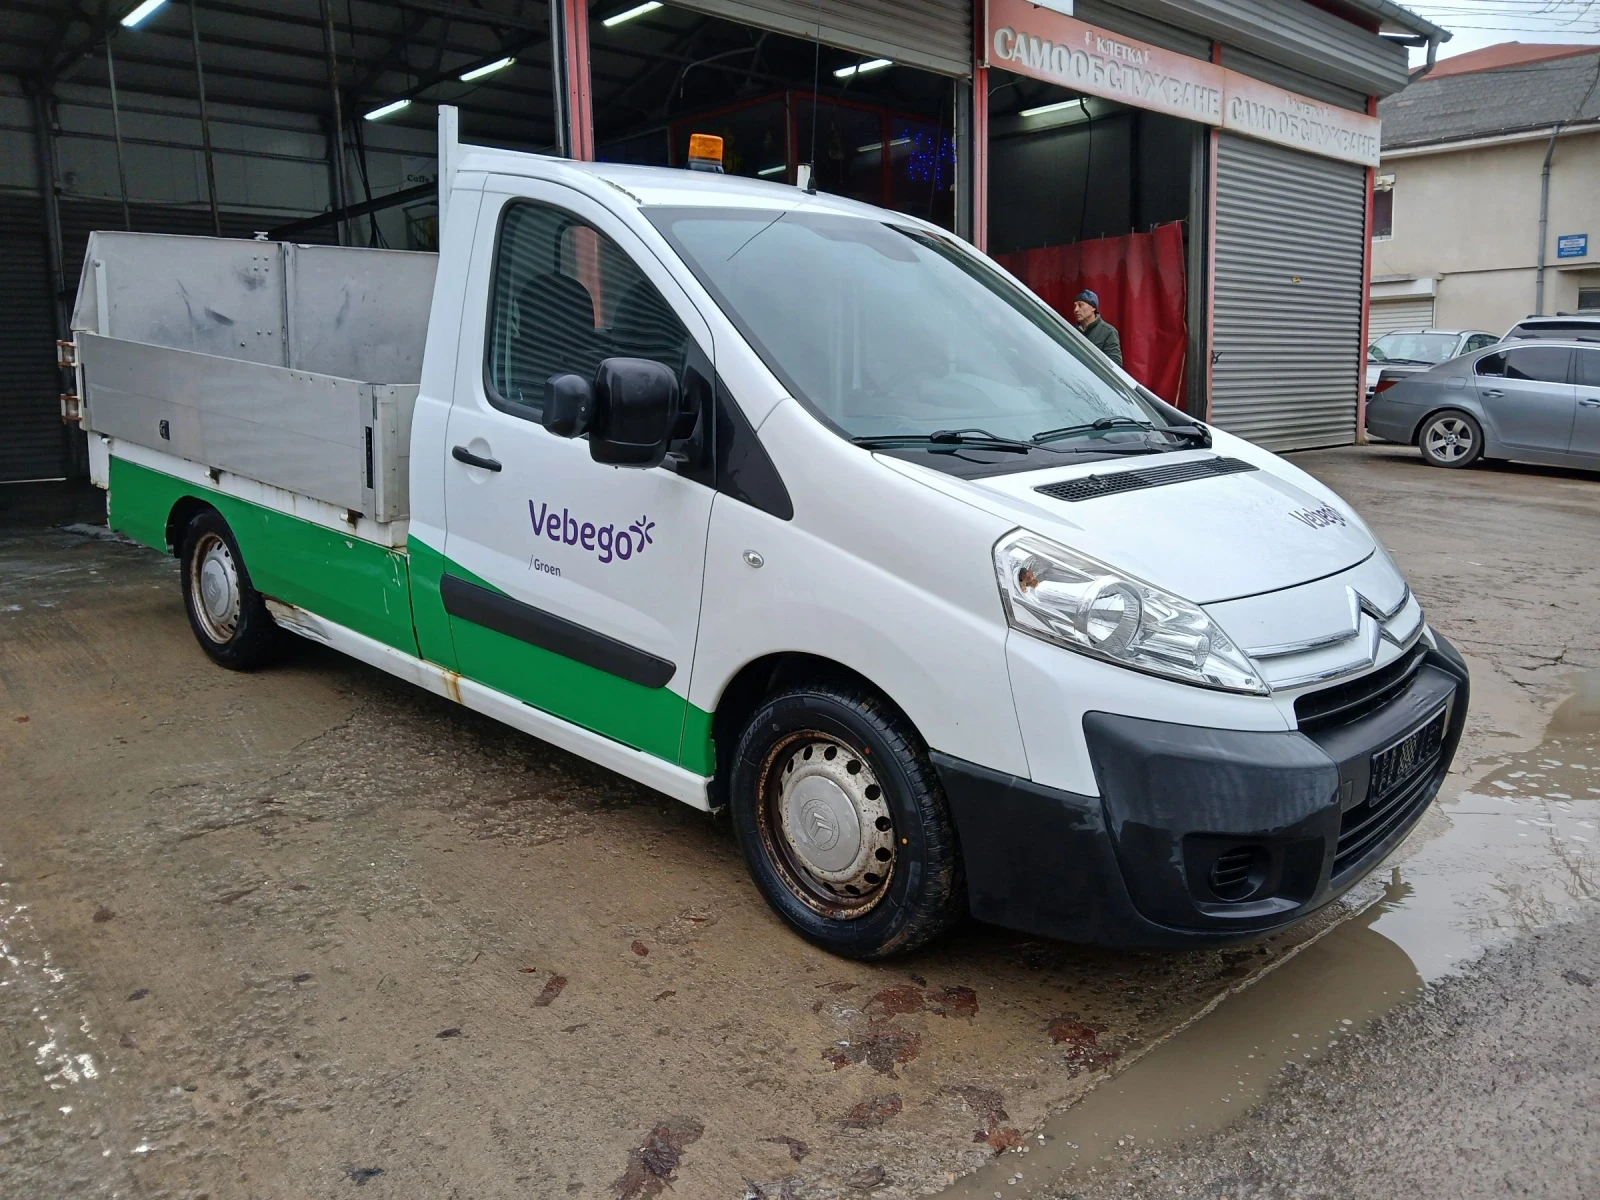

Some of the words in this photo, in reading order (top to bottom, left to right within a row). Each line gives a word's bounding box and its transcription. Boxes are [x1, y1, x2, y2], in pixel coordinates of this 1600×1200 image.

[993, 26, 1220, 116] САМООБСЛУЖВАНЕ
[1096, 36, 1143, 65] КЛЕТКА
[1229, 96, 1376, 159] САМООБСЛУЖВАНЕ
[528, 499, 632, 564] Vebego
